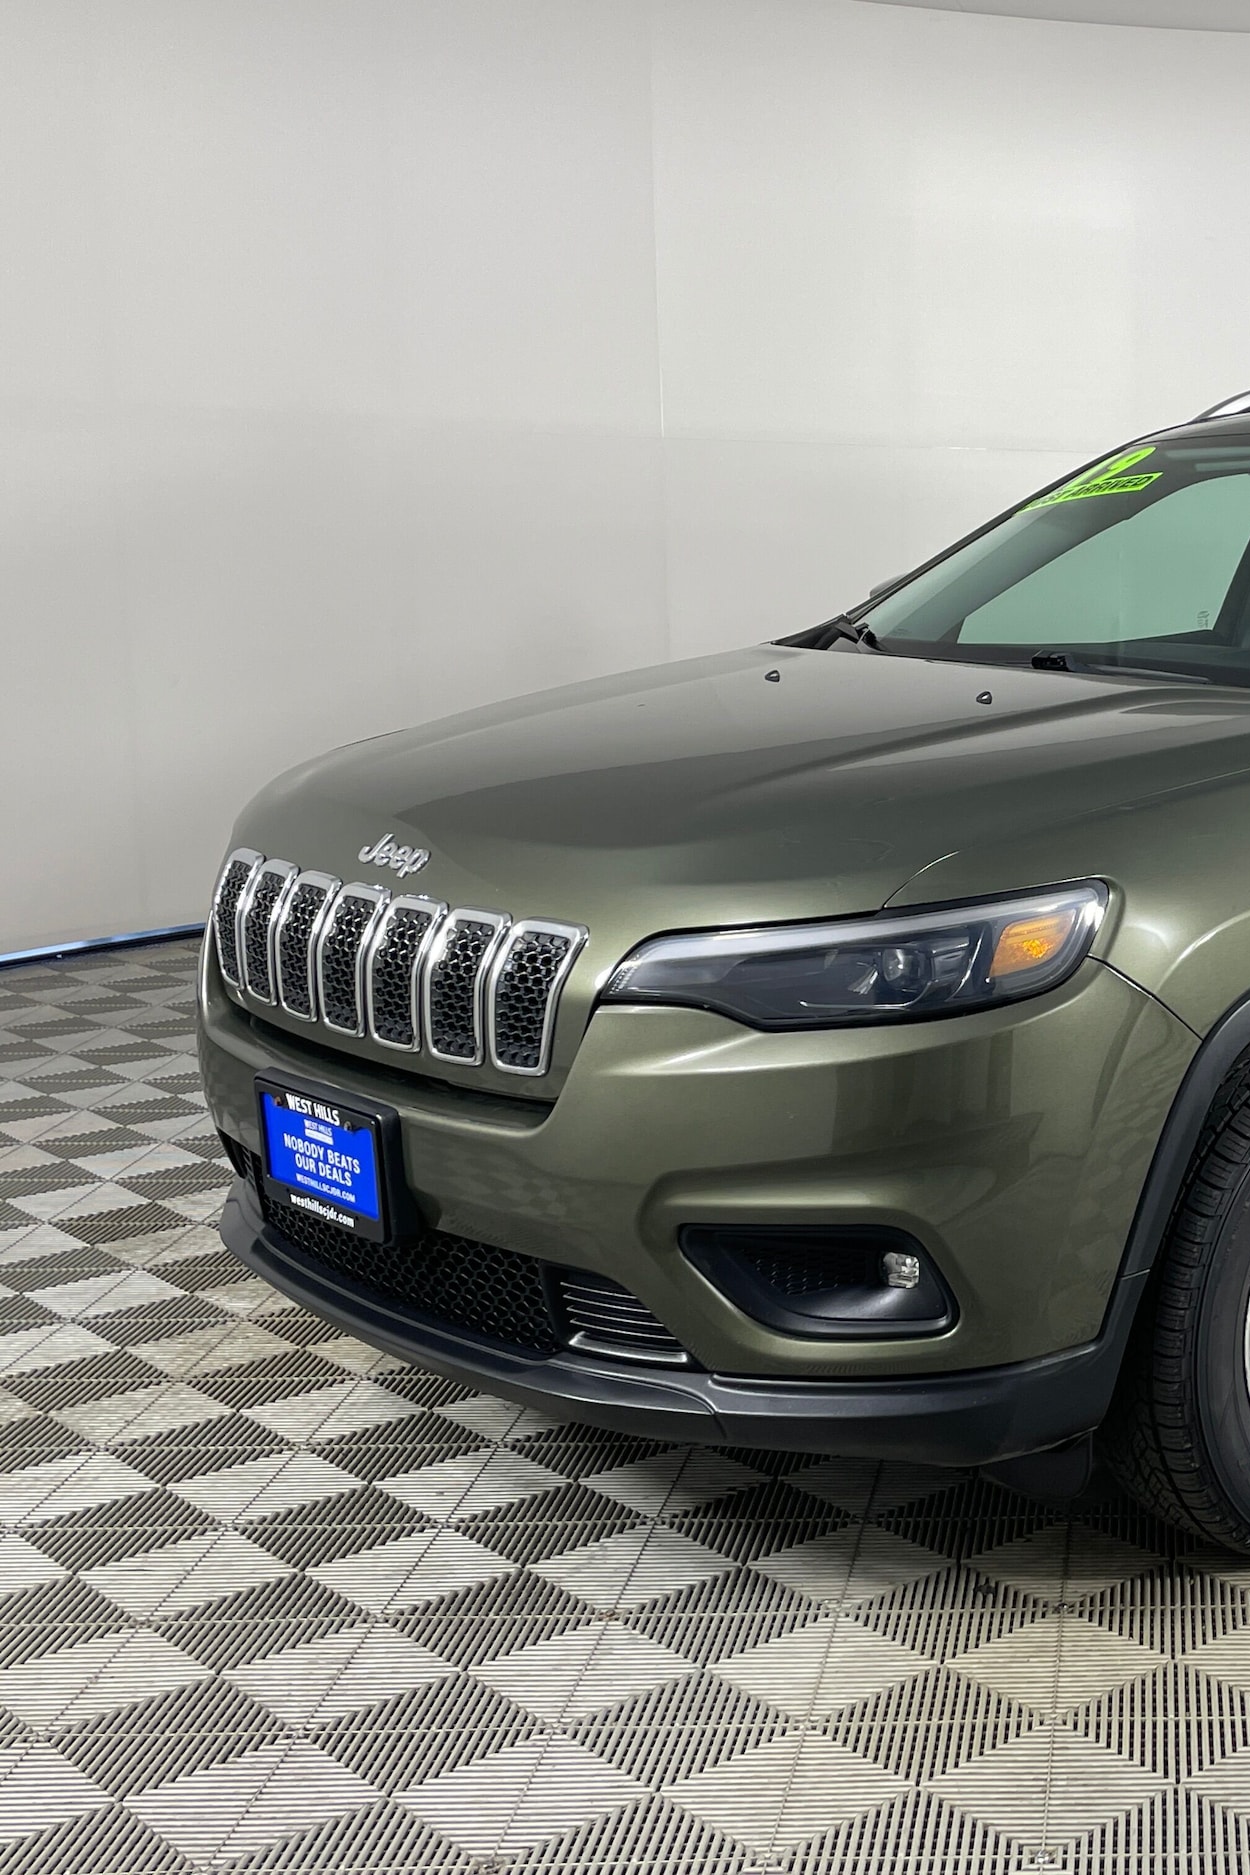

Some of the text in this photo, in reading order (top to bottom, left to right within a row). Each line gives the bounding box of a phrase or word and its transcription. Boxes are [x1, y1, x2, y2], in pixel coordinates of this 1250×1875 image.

[1062, 475, 1154, 500] ARRIVED
[358, 832, 431, 879] Jeep
[285, 1093, 340, 1126] WEST HILLS
[283, 1133, 325, 1161] NOBODY
[327, 1149, 360, 1174] BEATS
[295, 1153, 352, 1187] OUR DEALS
[290, 1193, 354, 1228] westhillscjdr.com
